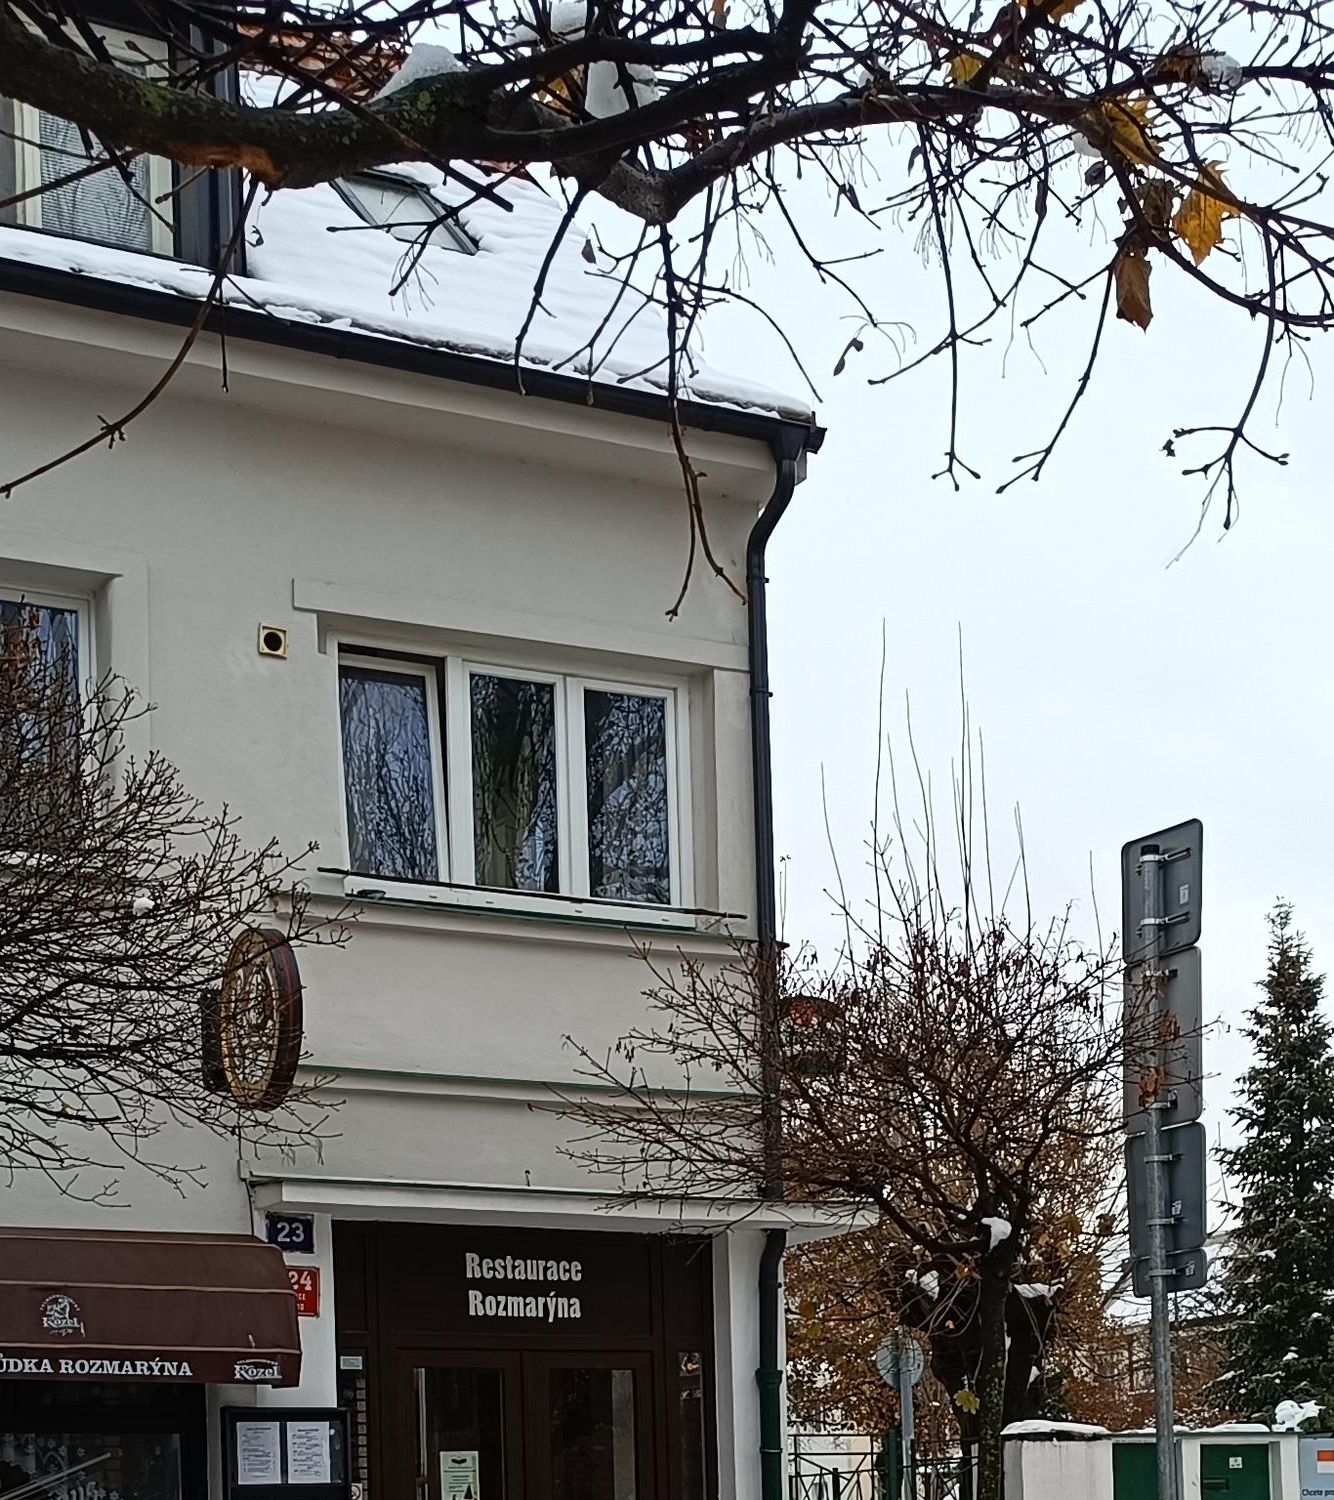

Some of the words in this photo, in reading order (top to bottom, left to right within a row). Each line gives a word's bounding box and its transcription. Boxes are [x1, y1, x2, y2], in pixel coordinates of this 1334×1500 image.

[276, 1221, 305, 1243] 23
[466, 1252, 582, 1281] Restaurace
[468, 1290, 581, 1323] Rozmarýna
[59, 1355, 193, 1377] ROZMARÝNA
[233, 1364, 283, 1380] Kozel
